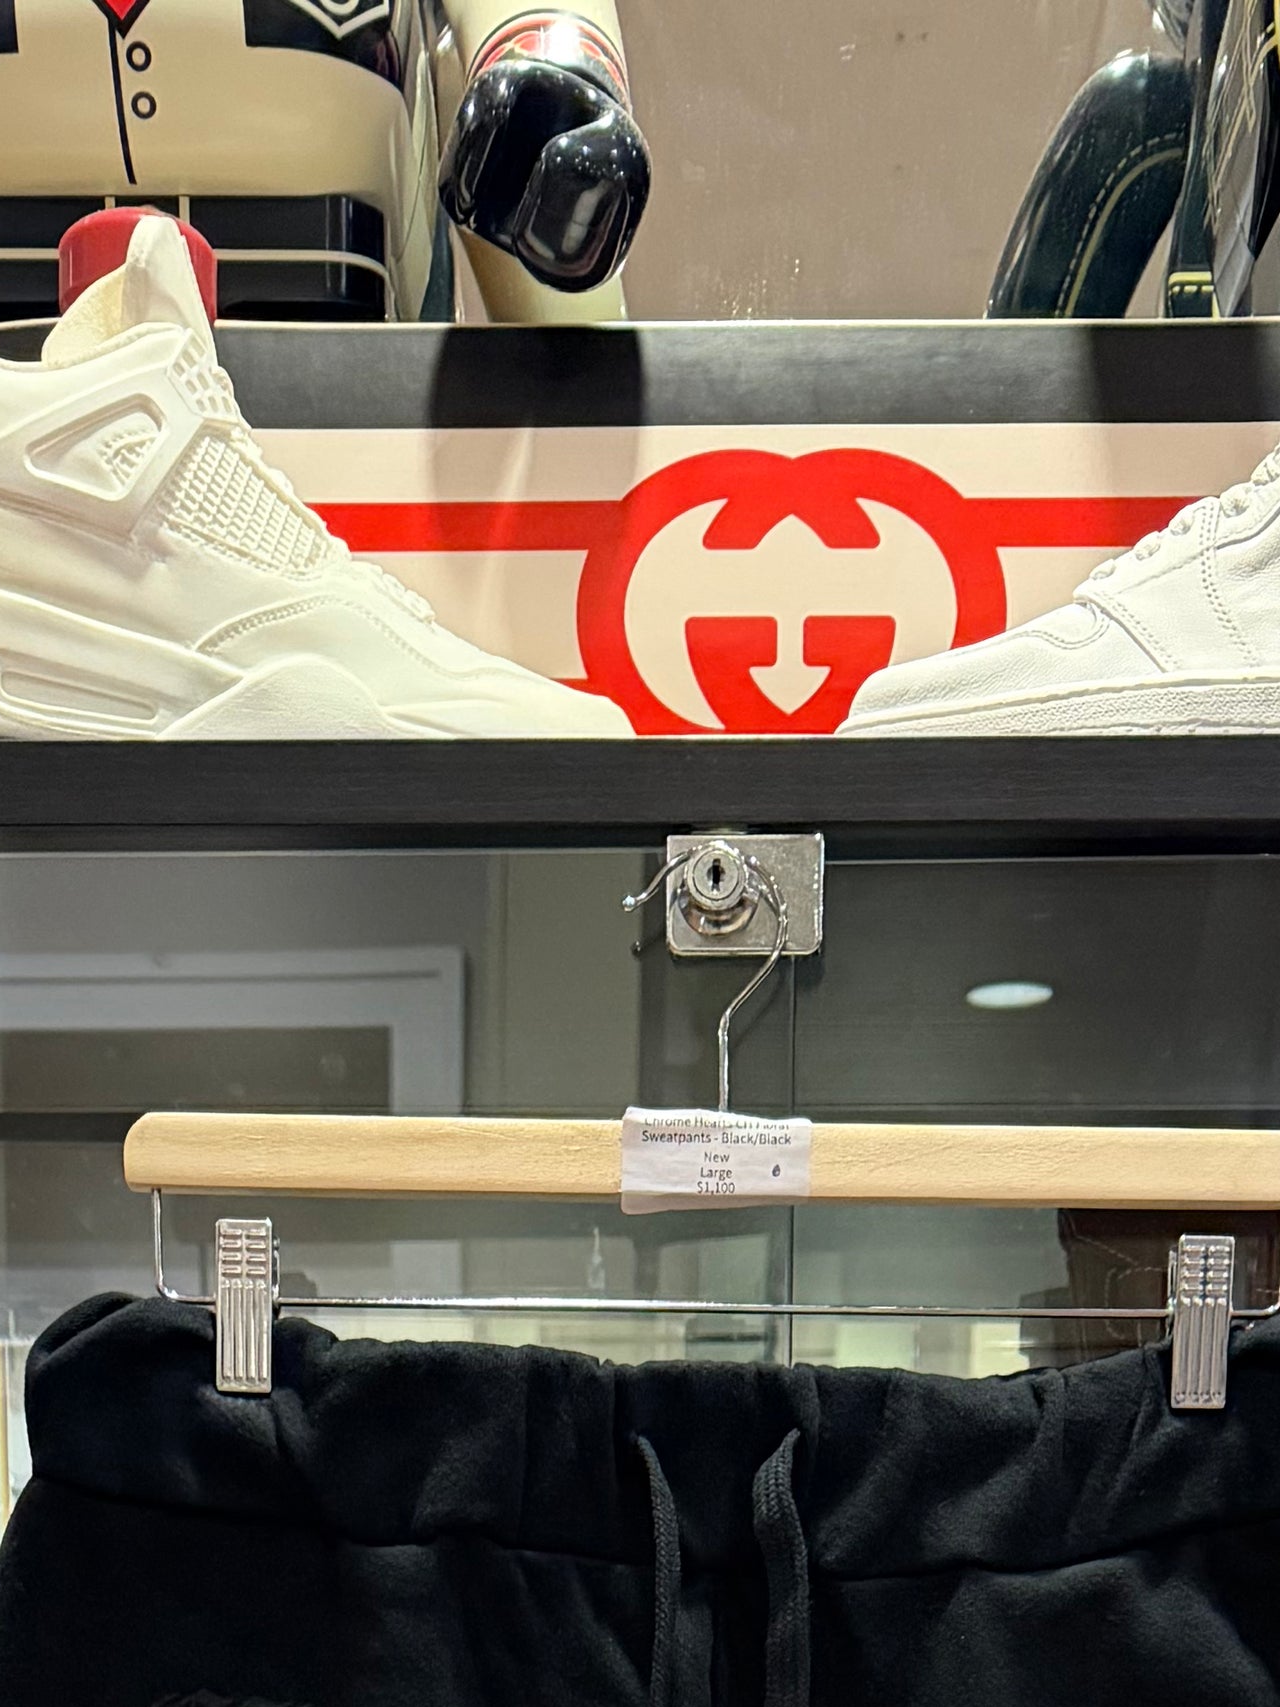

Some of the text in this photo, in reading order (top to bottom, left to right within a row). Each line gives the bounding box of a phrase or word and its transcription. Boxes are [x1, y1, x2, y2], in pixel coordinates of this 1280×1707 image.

[642, 1129, 712, 1146] Sweatpants
[721, 1131, 792, 1146] Black/Black
[704, 1151, 731, 1163] New
[700, 1167, 733, 1182] Large
[696, 1181, 736, 1195] $1,100
